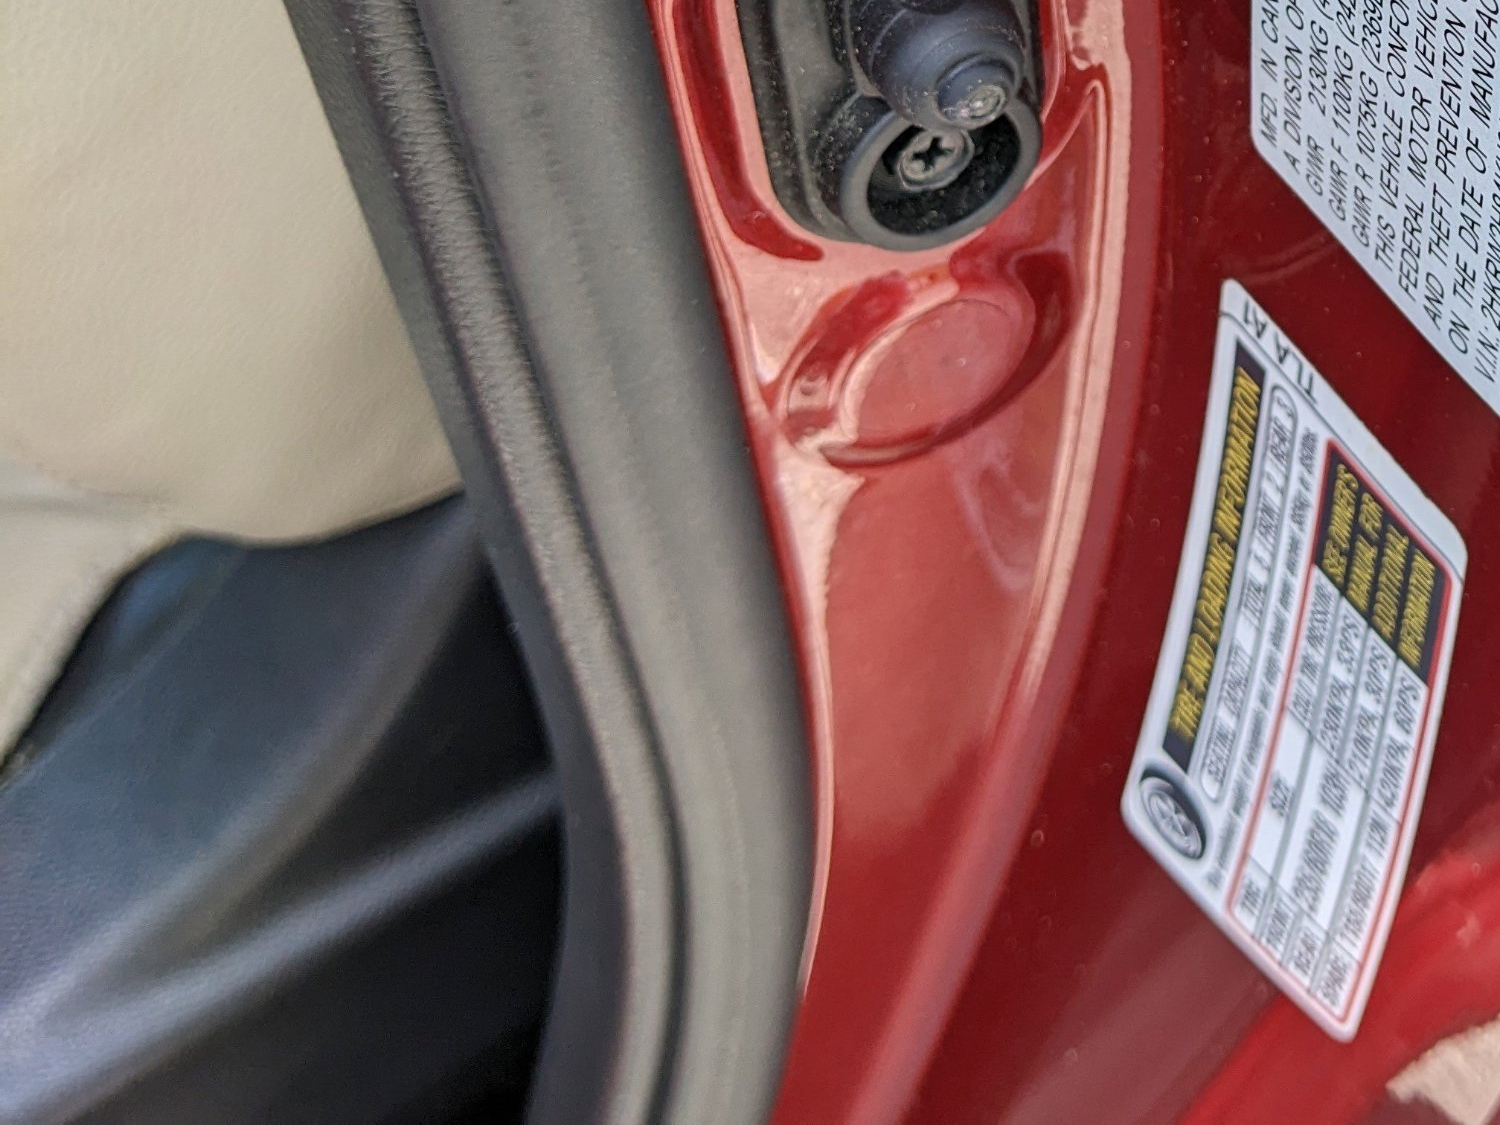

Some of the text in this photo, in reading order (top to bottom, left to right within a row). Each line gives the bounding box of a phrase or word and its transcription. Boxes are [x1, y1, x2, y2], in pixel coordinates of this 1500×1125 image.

[1260, 48, 1277, 82] IN
[1282, 34, 1303, 146] DIVISION
[1307, 19, 1329, 117] 2130KG
[1331, 44, 1354, 137] 1100KG
[1434, 6, 1466, 184] PREVENTION
[1260, 91, 1278, 147] MFD.
[1330, 136, 1348, 162] F
[1355, 69, 1379, 162] 1075KG
[1406, 85, 1432, 188] MOTOR
[1464, 126, 1487, 175] OF
[1282, 149, 1300, 174] A
[1305, 134, 1324, 196] GVWR
[1327, 159, 1348, 221] GAWR
[1354, 162, 1374, 189] R
[1378, 99, 1403, 210] VEHICLE
[1351, 184, 1372, 248] GAWR
[1373, 213, 1396, 272] THIS
[1397, 192, 1424, 302] FEDERAL
[1427, 181, 1452, 267] THEFT
[1457, 175, 1484, 255] DATE
[1422, 270, 1445, 331] AND
[1451, 251, 1477, 308] THE
[1275, 332, 1317, 404] TLA
[1447, 309, 1470, 355] ON
[1473, 325, 1499, 383] V.I.N.:
[1271, 415, 1291, 470] REAR
[1171, 362, 1260, 743] TIRE AND LOADING INFORMATION
[1321, 458, 1359, 588] SEE OWNER'S
[1346, 486, 1383, 615] MANUAL FOR
[1371, 516, 1409, 644] ADDITIONAL
[1396, 544, 1435, 673] INFORMATION
